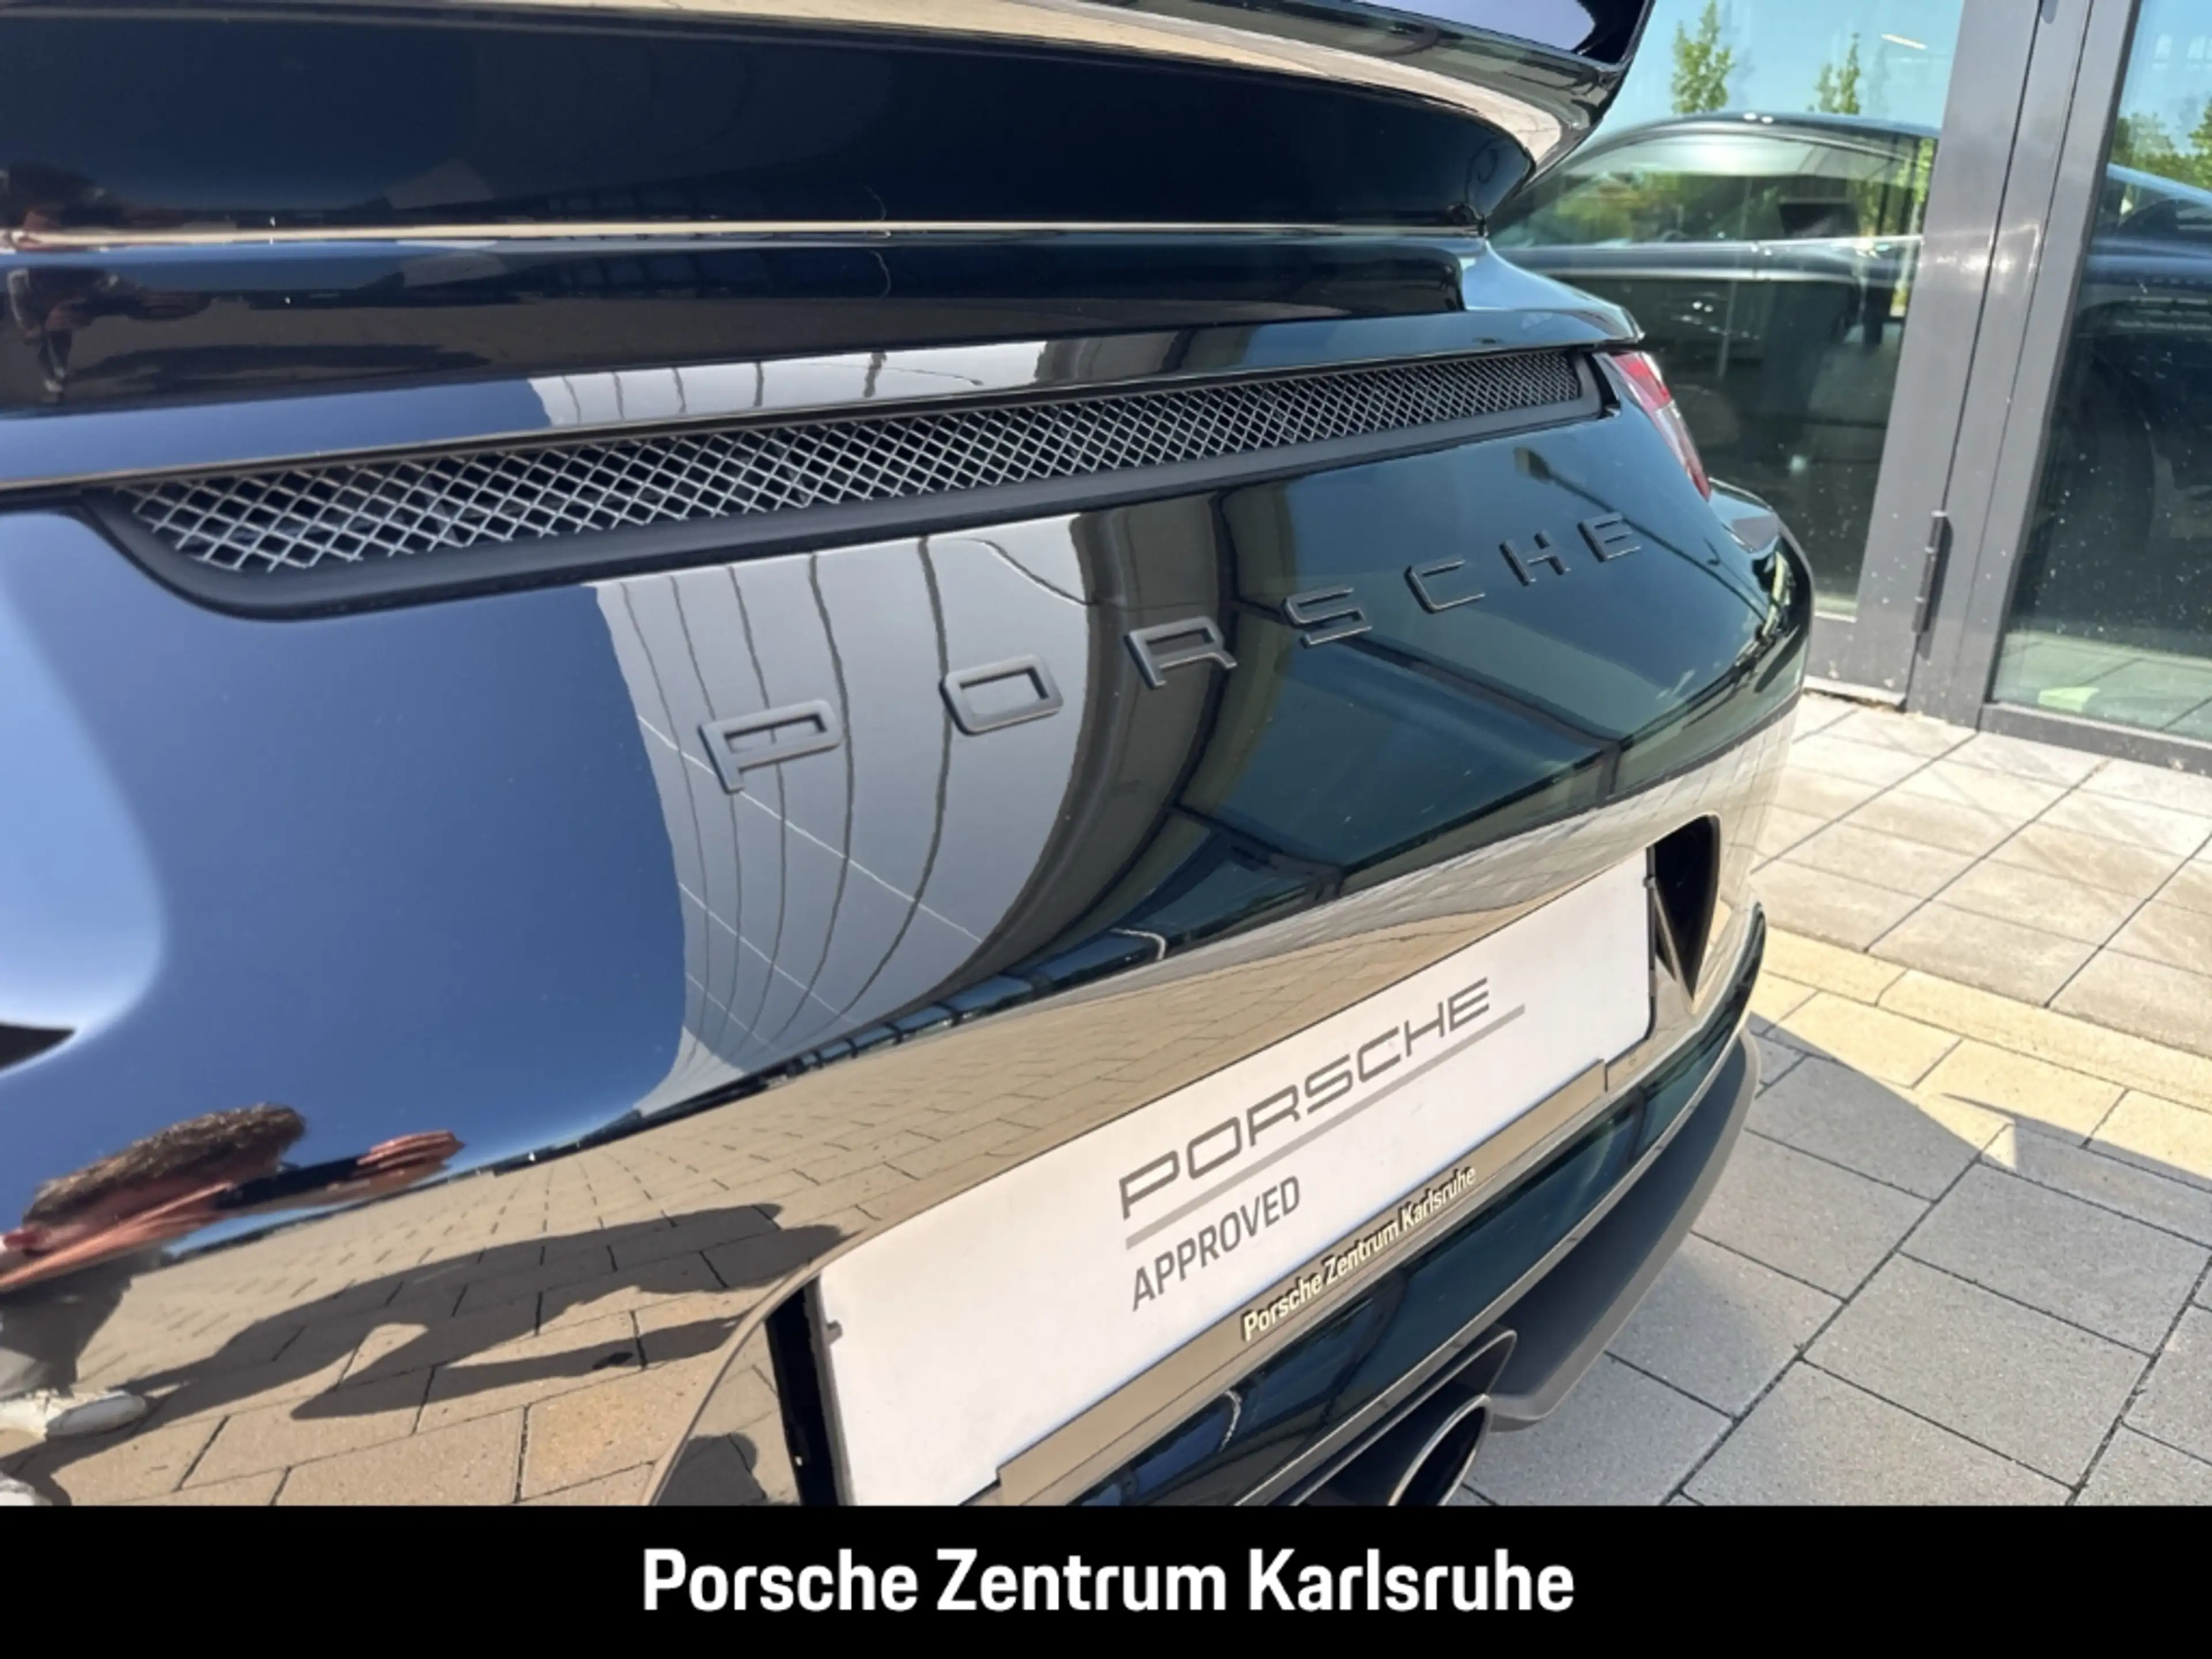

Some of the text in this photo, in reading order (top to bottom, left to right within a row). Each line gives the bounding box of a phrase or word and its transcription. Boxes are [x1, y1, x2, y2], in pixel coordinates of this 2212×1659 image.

[696, 512, 1644, 795] PORSCHE
[1119, 977, 1490, 1220] PORSCHE
[1132, 1176, 1301, 1312] APPROVED
[1241, 1165, 1478, 1342] Porsche Zentrum Karlsruhe
